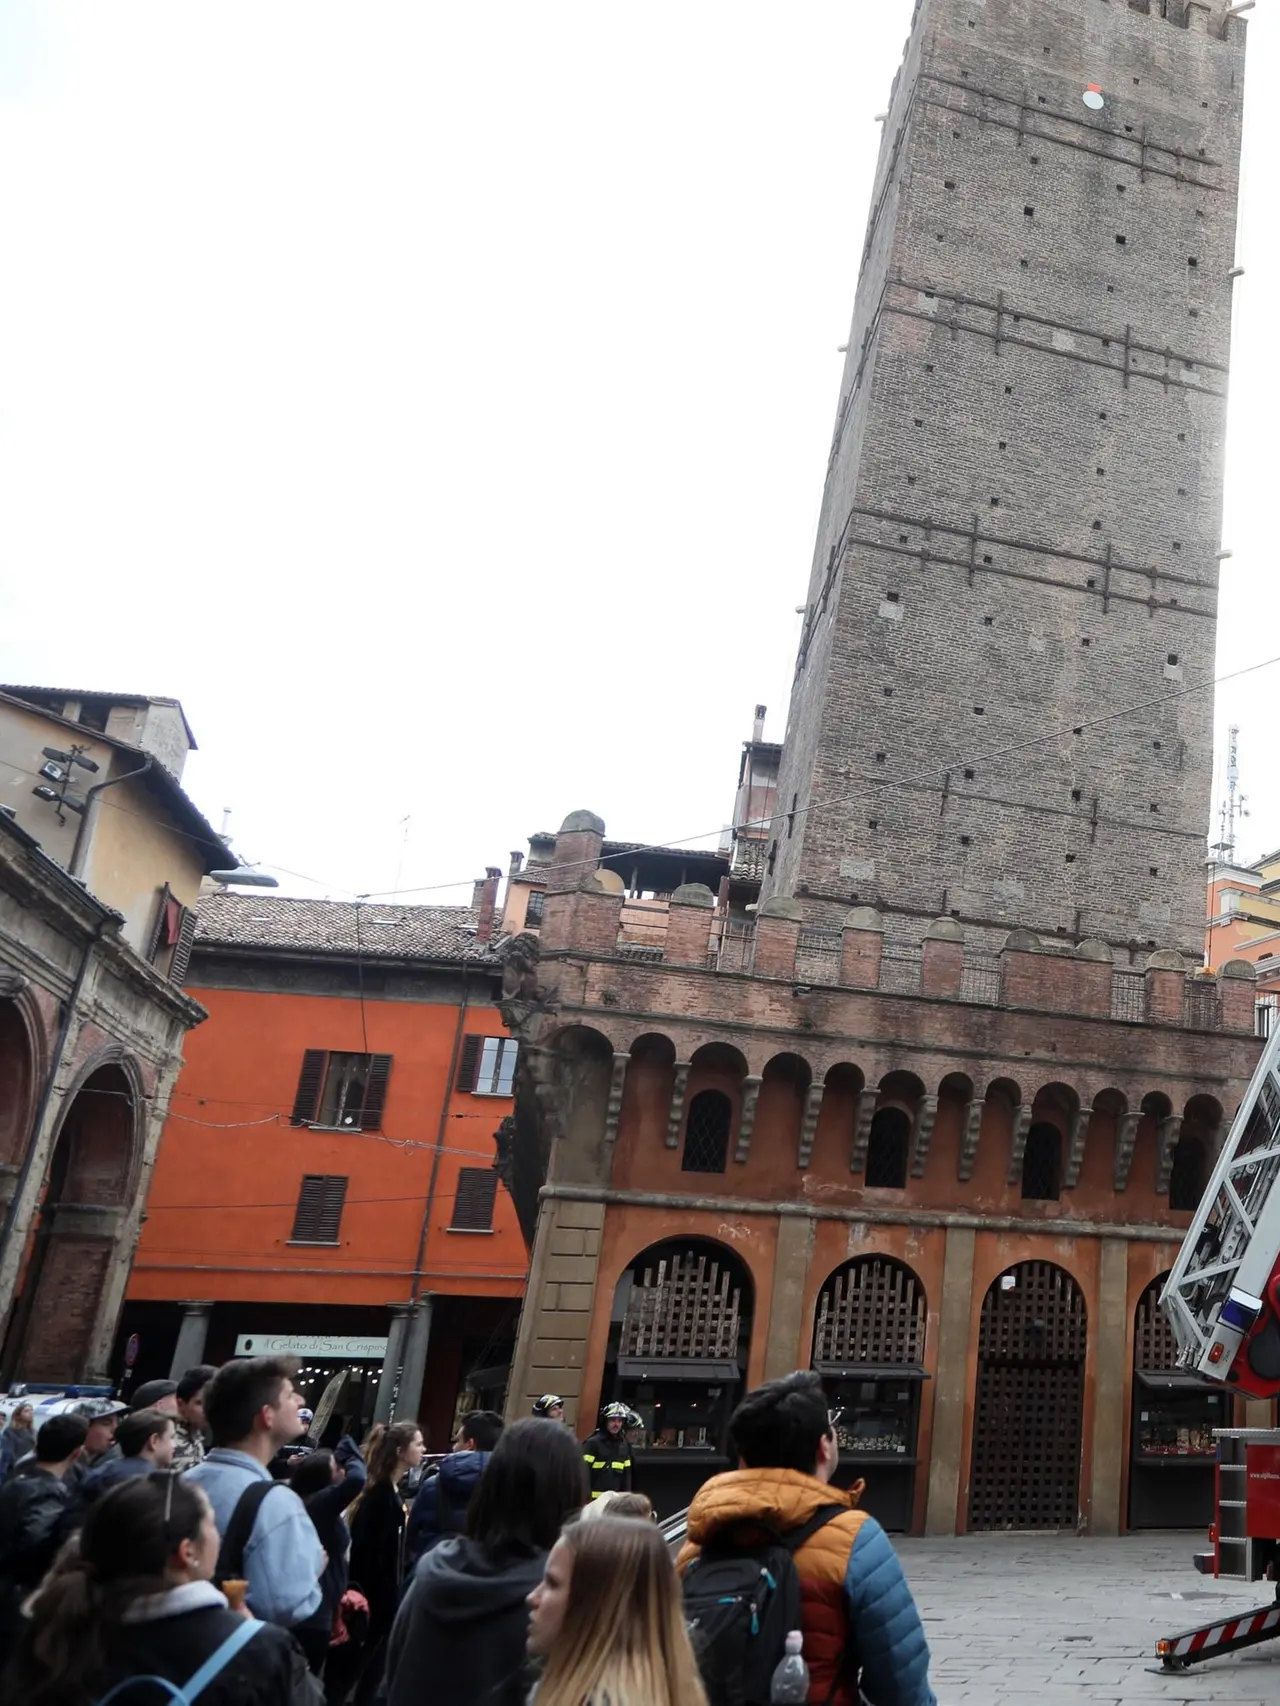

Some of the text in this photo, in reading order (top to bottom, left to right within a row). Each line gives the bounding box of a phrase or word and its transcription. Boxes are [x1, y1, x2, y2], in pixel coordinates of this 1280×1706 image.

[271, 1338, 307, 1351] Gelato
[309, 1337, 319, 1350] di
[320, 1339, 343, 1352] San
